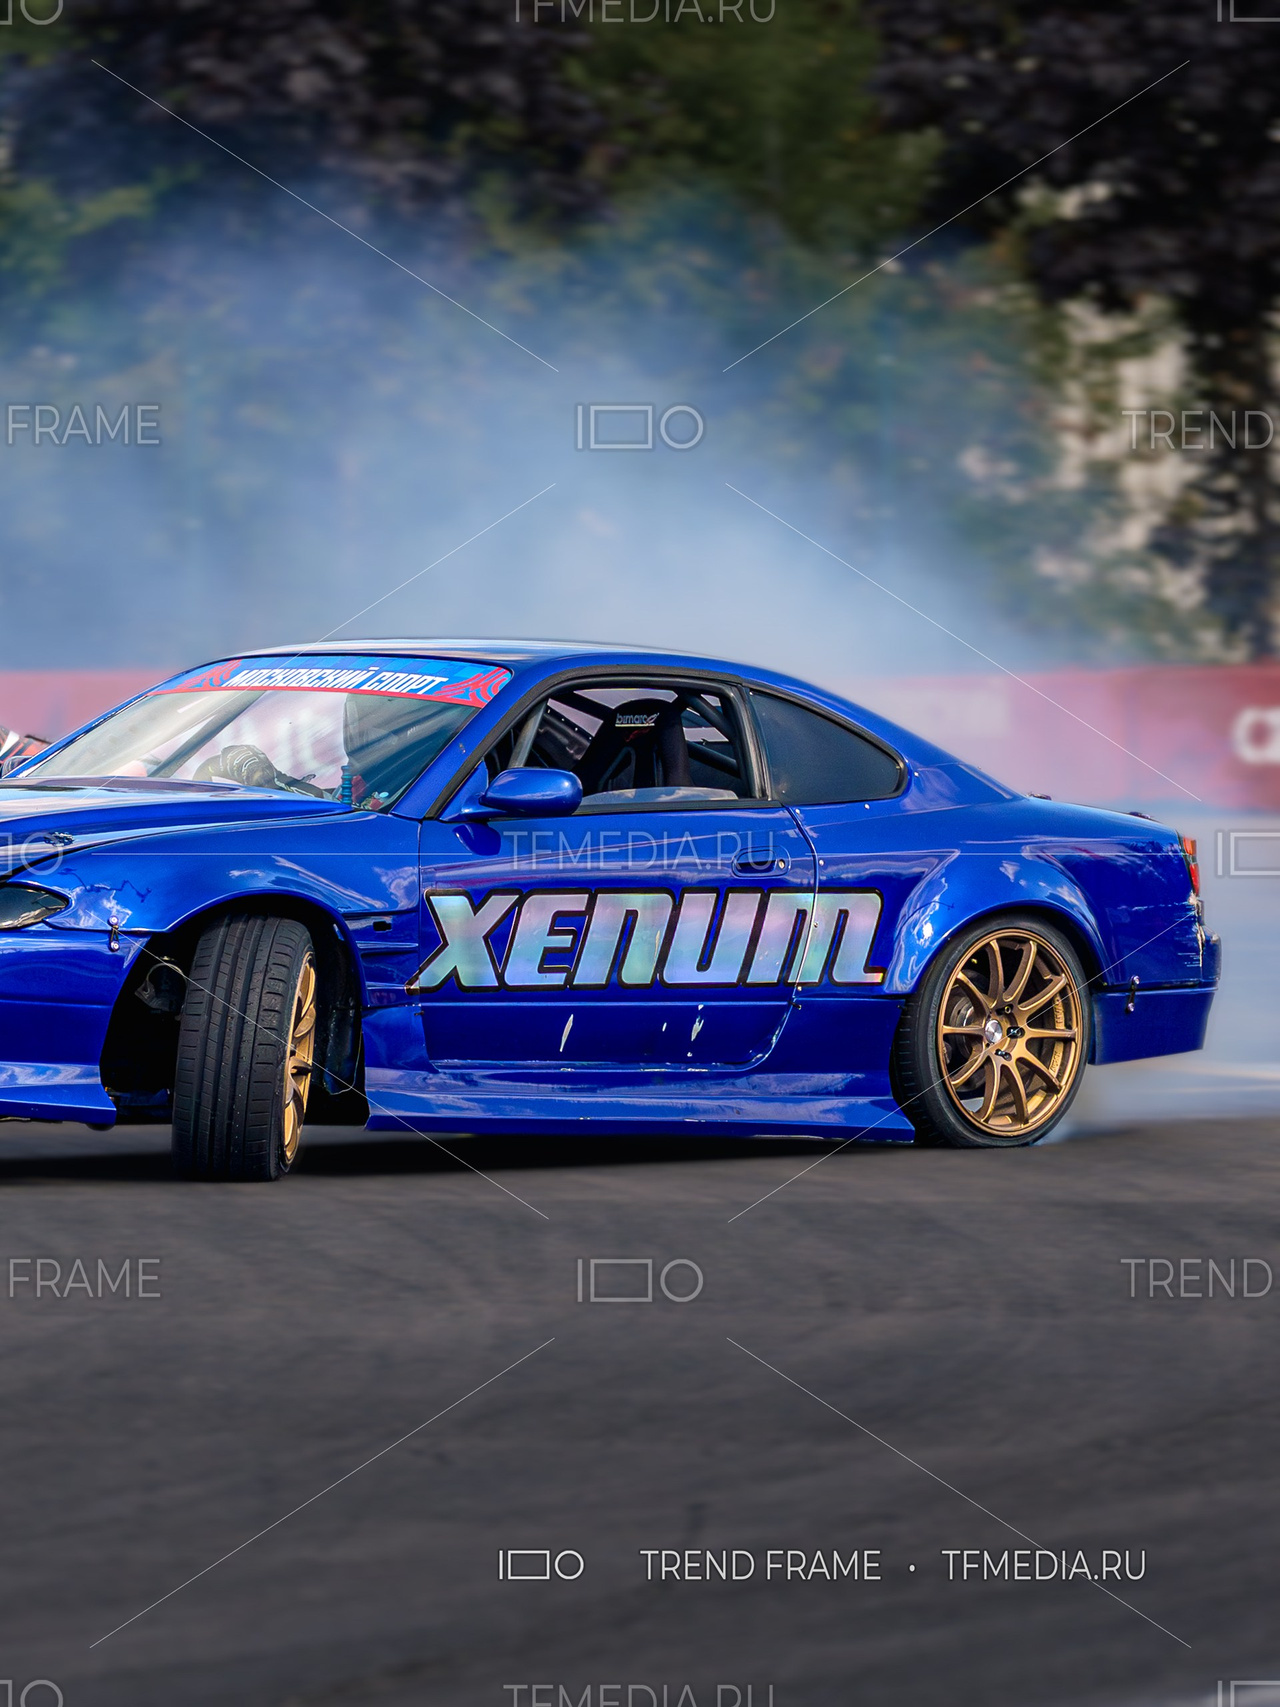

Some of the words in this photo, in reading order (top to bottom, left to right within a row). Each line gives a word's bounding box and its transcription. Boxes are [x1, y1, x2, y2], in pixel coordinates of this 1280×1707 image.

[220, 667, 380, 688] МОСКОВСКИЙ
[359, 671, 449, 695] СПОРТ
[405, 887, 886, 994] XENUM
